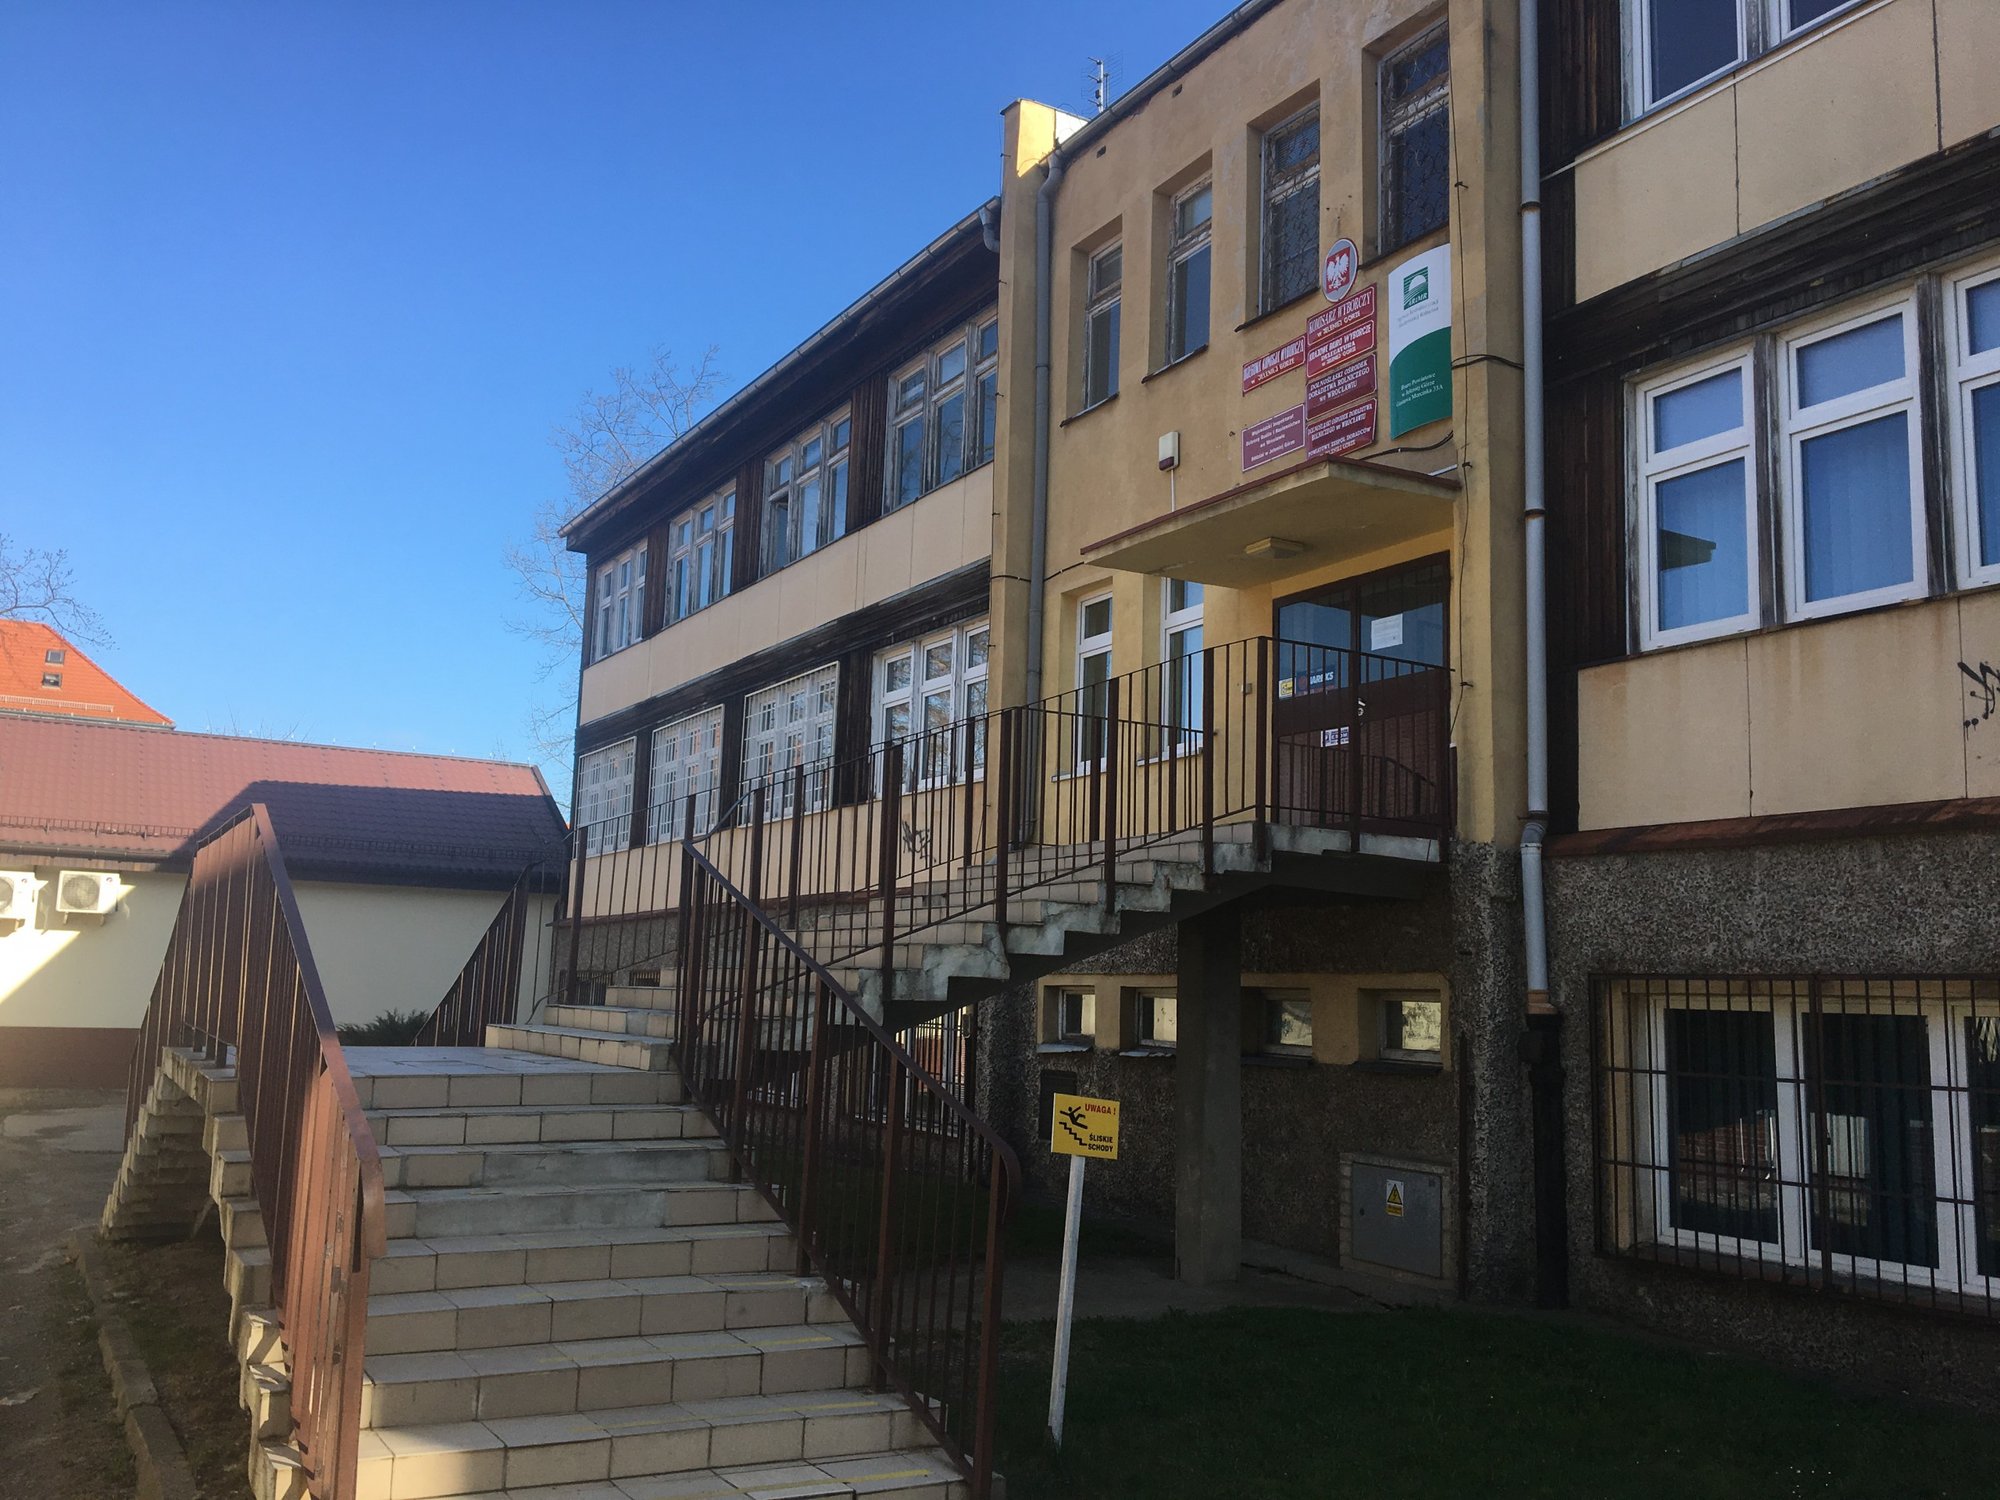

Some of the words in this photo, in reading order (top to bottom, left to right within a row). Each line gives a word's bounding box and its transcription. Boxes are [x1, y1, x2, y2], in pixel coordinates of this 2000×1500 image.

[1337, 291, 1372, 318] WYBORCZY
[1085, 1103, 1111, 1114] UWAGA
[1089, 1133, 1113, 1143] ŚLISKIE
[1088, 1144, 1113, 1152] SCHODY
